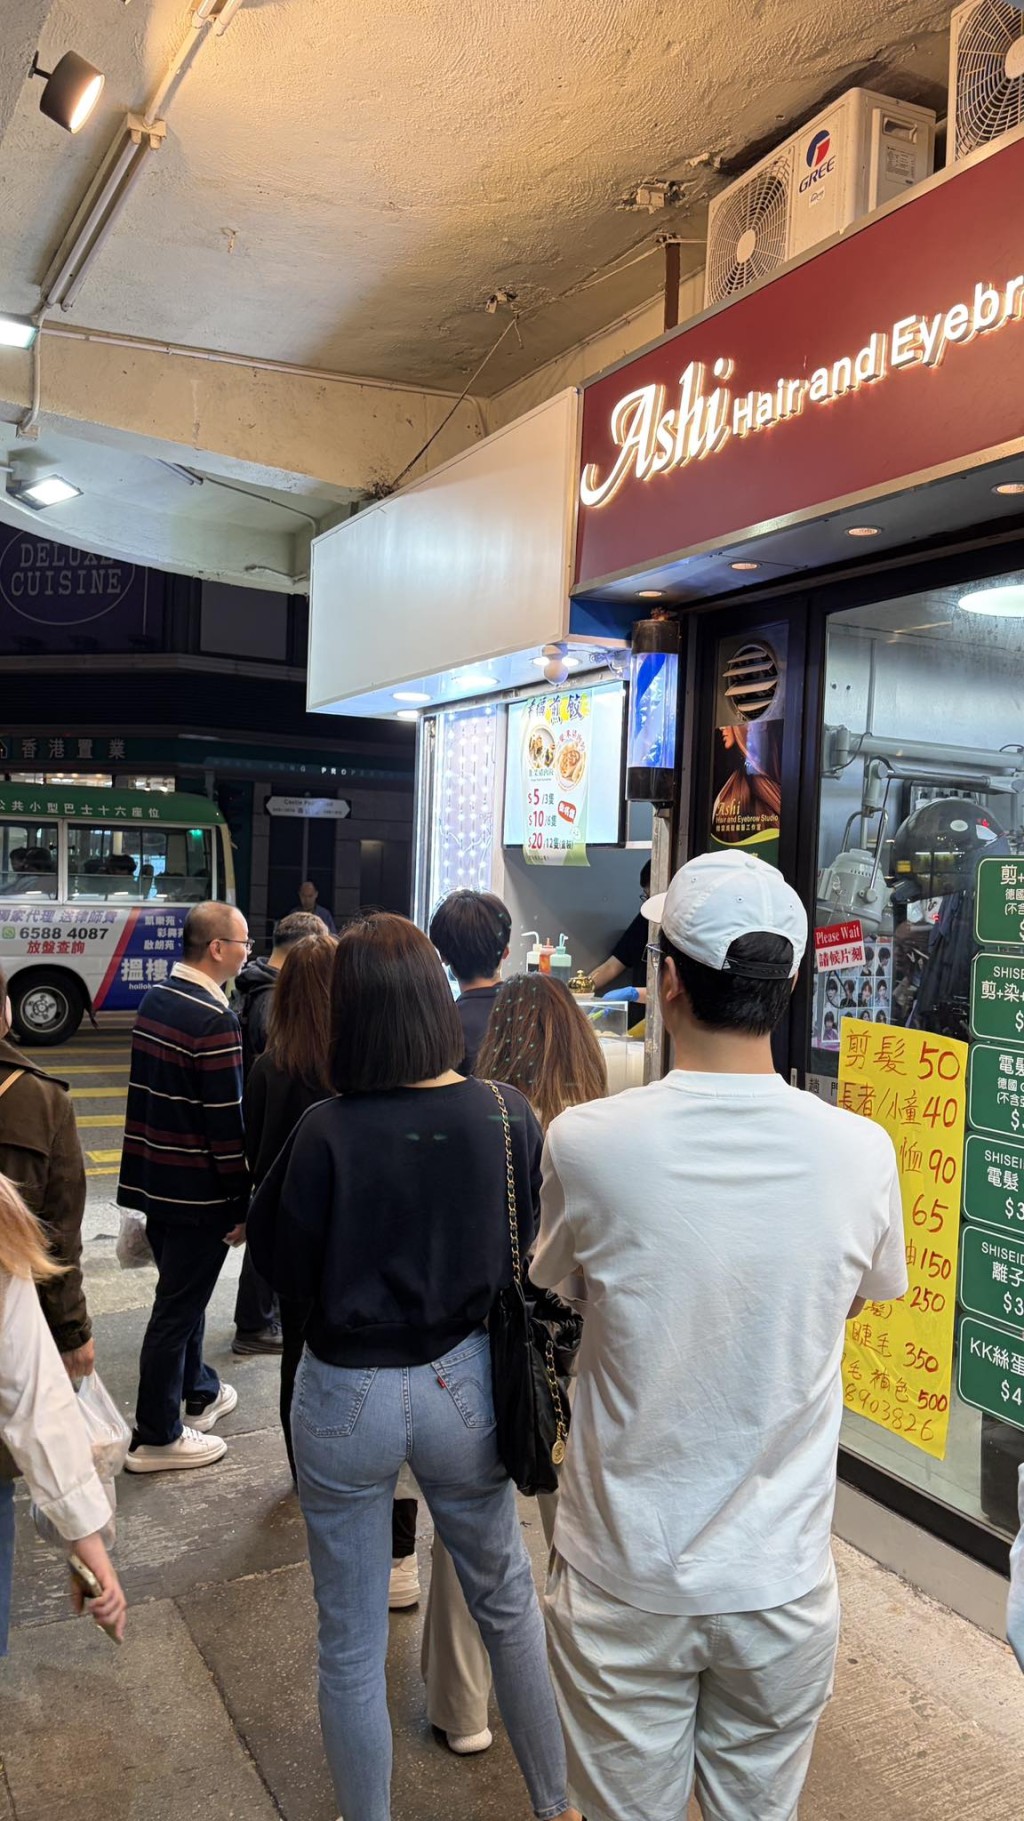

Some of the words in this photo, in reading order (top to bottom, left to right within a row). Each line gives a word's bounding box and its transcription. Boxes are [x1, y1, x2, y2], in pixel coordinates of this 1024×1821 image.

[799, 155, 836, 193] GREE
[580, 358, 732, 507] Ashi
[733, 379, 811, 440] Hair
[810, 332, 889, 404] and
[890, 274, 1024, 369] Eyebr
[11, 568, 122, 596] CUISINE
[715, 799, 741, 816] Ashi
[727, 815, 737, 824] and
[737, 814, 760, 824] Eyebrow
[761, 813, 779, 823] Studio
[19, 926, 62, 940] 6588
[67, 926, 110, 940] 4087
[816, 931, 840, 945] Please
[840, 925, 861, 940] Wait
[27, 940, 86, 954] 放盤查詢
[819, 945, 863, 967] 請候片刻
[121, 957, 172, 982] 搵樓
[845, 1029, 908, 1077] 剪髮
[917, 1040, 961, 1081] 50
[922, 1095, 959, 1129] 40
[928, 1149, 957, 1184] 90
[984, 1149, 1024, 1170] SHISEI
[912, 1193, 949, 1233] 65
[921, 1248, 952, 1280] 150
[910, 1285, 946, 1313] 250
[903, 1342, 940, 1372] 350
[917, 1389, 949, 1413] 500
[1001, 1379, 1022, 1406] $4
